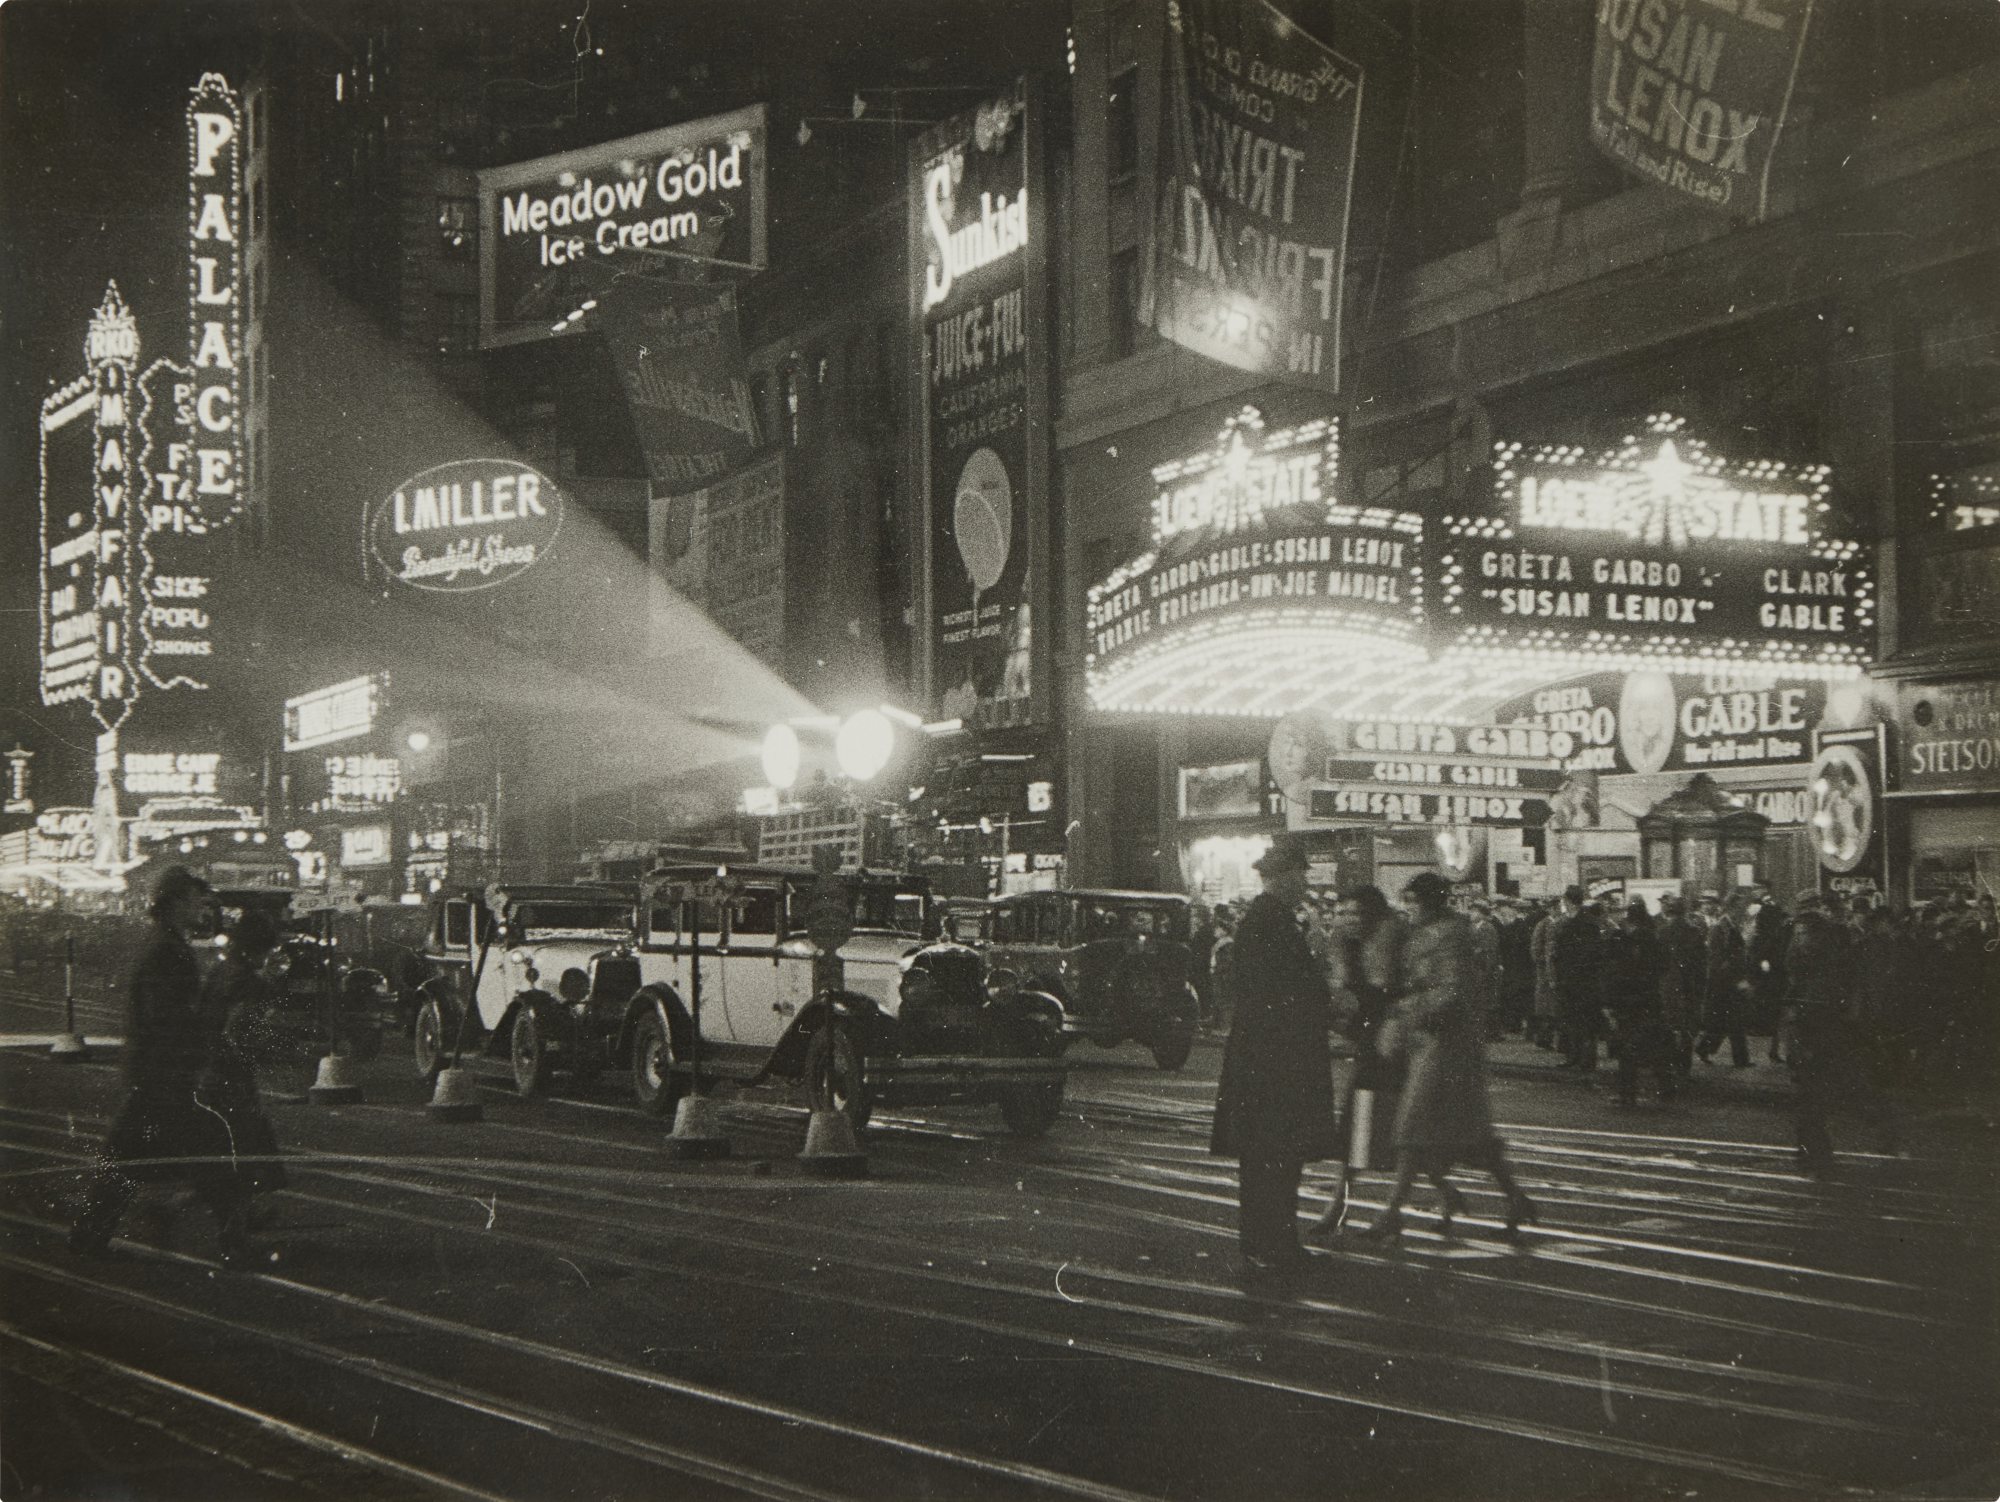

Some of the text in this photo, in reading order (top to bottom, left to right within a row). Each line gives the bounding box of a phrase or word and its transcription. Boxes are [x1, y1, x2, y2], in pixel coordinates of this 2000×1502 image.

[1607, 48, 1762, 173] LENOX
[503, 144, 743, 236] Meadow Gold
[541, 211, 698, 267] Ice Cream
[922, 163, 1028, 314] Sunkist
[194, 112, 234, 495] PALACE
[413, 473, 547, 531] MILLER
[1688, 489, 1809, 544] STATE
[101, 394, 124, 699] MAYFAIR
[1342, 537, 1403, 569] LENOX
[1481, 551, 1681, 588] GRETA GARBO
[1763, 568, 1848, 597] CLARK
[1759, 602, 1845, 632] GABLE
[1355, 723, 1574, 758] GRETA GARBO
[1679, 688, 1807, 738] GABLE
